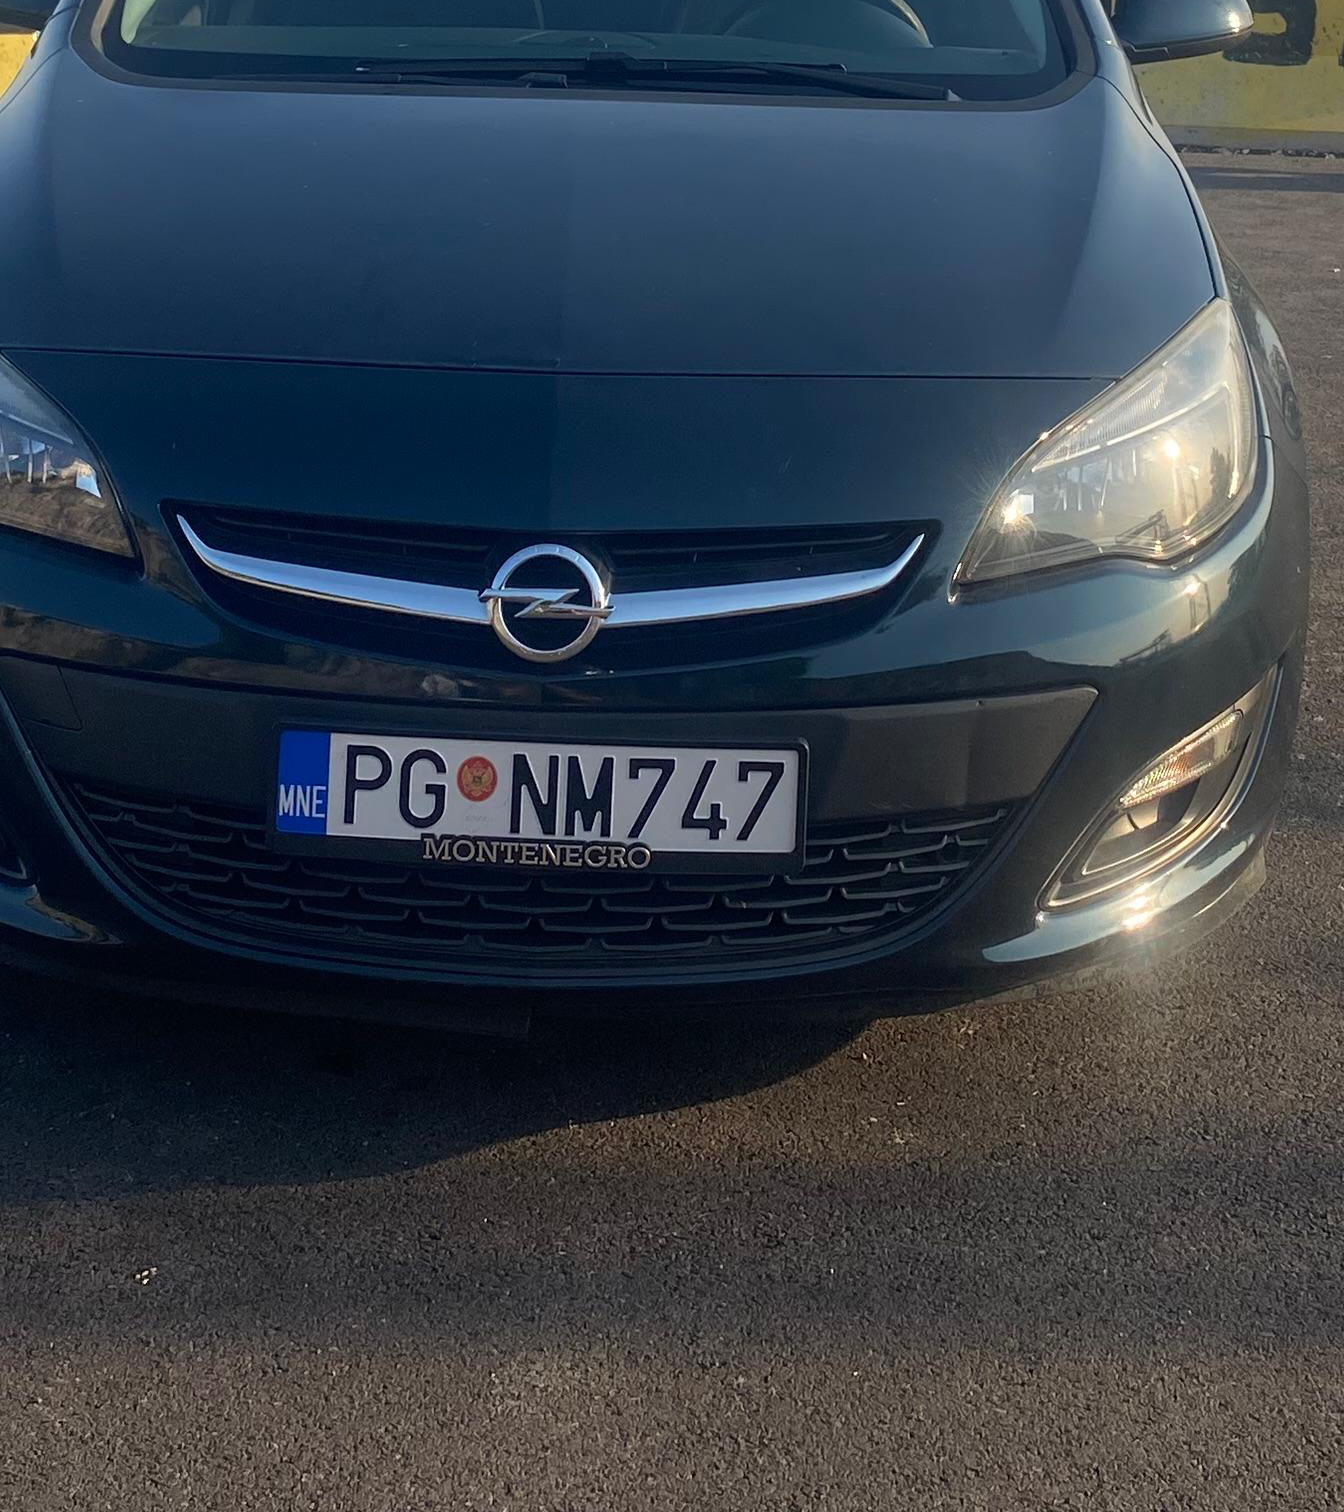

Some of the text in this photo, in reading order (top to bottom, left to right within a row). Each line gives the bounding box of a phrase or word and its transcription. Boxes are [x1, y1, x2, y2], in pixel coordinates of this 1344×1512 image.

[278, 785, 326, 818] MNE
[342, 744, 786, 840] PG NM747
[423, 836, 651, 869] MONTENEGRO
